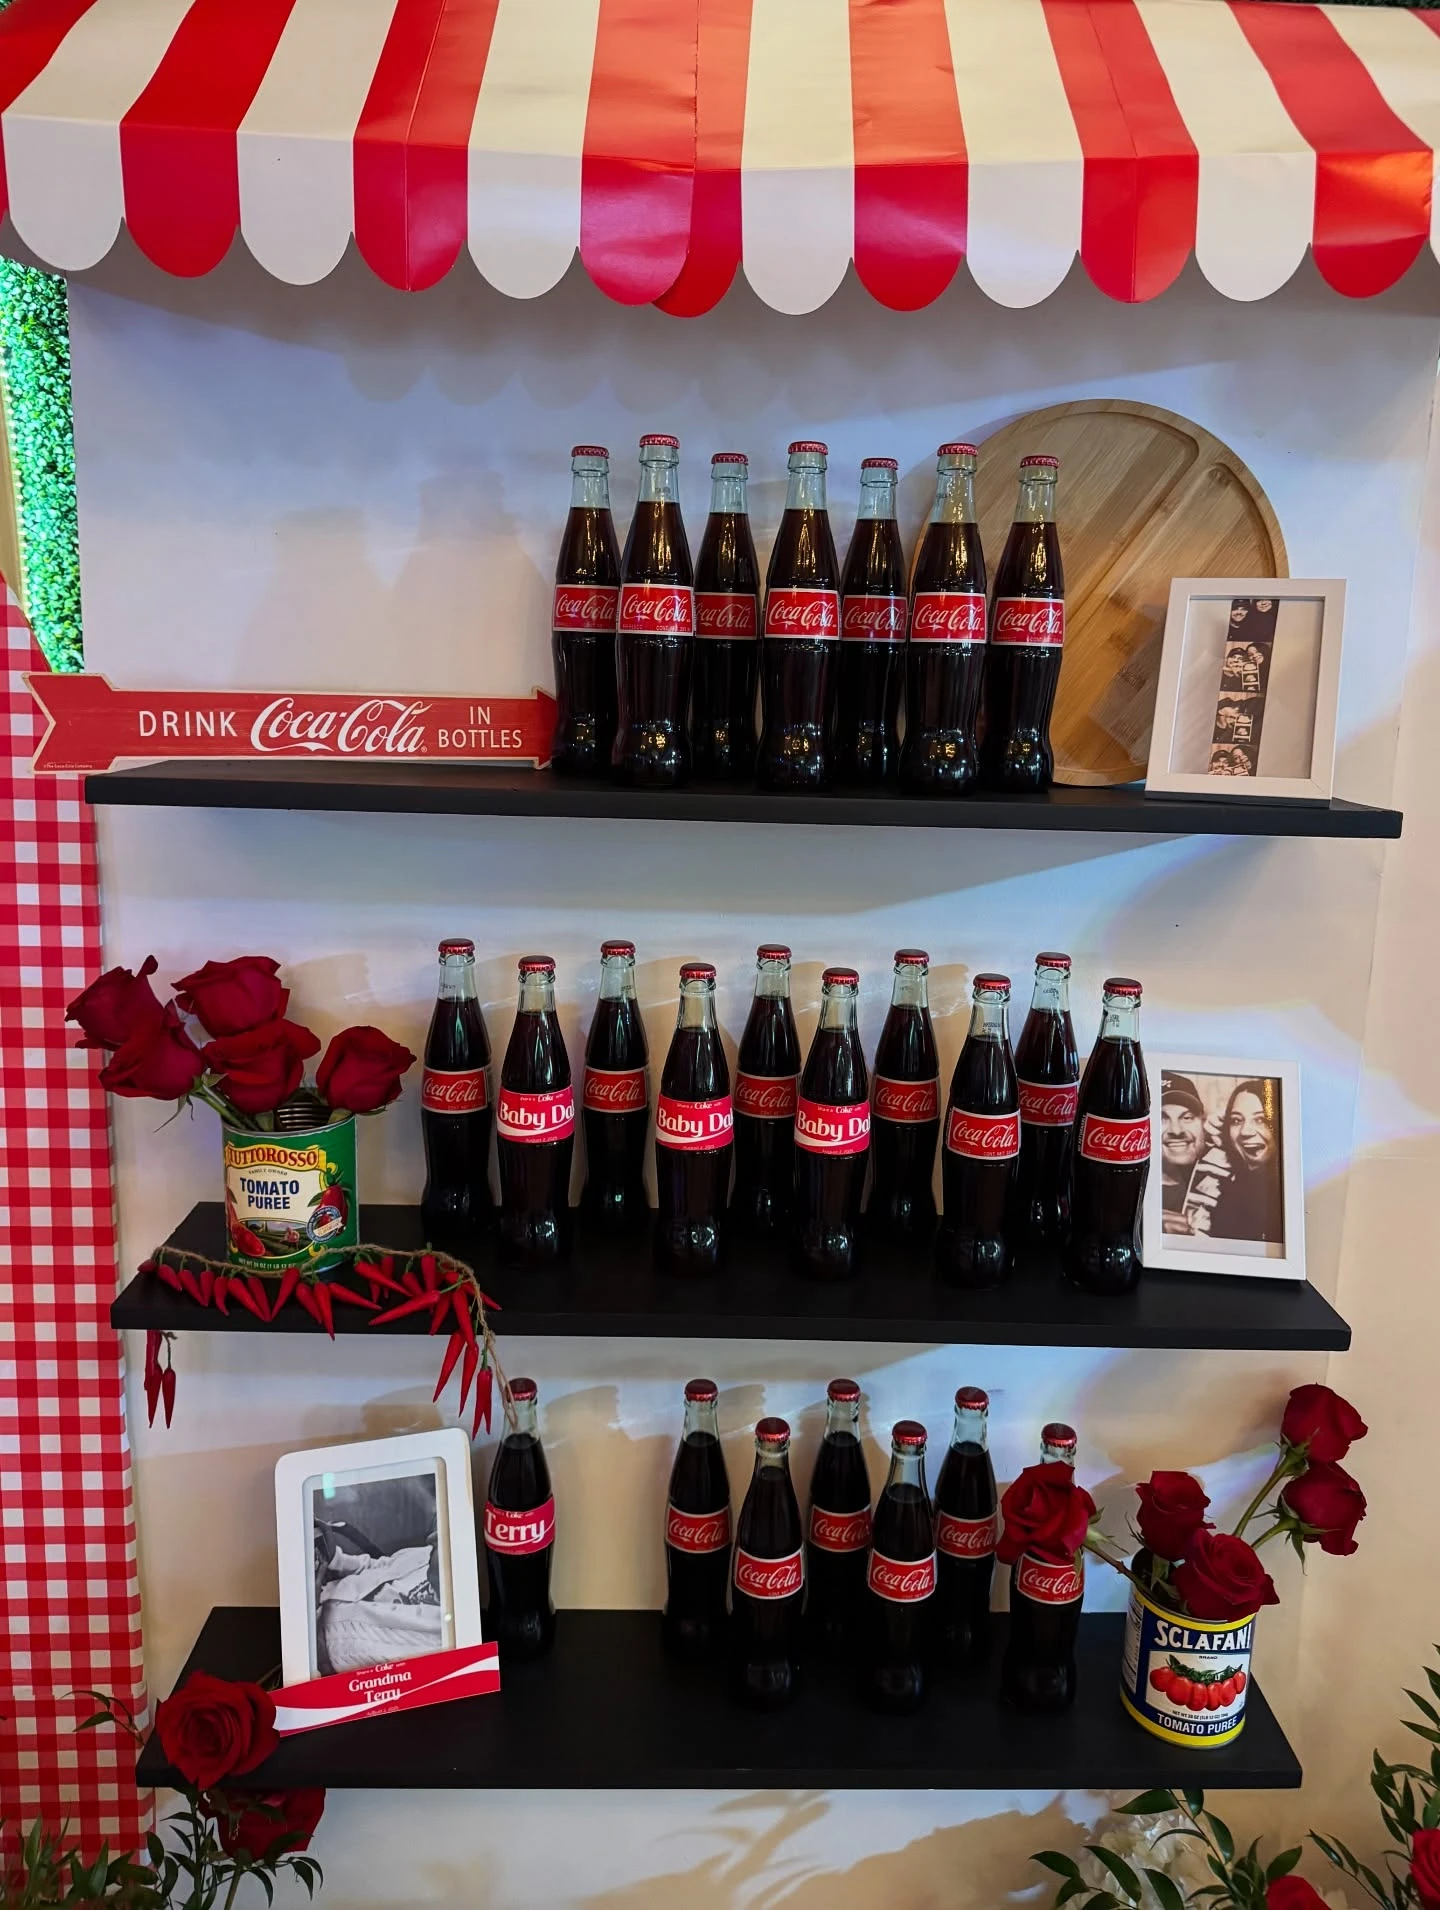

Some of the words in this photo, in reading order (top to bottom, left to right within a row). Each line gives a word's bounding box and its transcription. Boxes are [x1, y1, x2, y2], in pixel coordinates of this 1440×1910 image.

[556, 594, 614, 619] Coca-Cola
[623, 594, 688, 621] Coca-Cola
[769, 599, 834, 628] Coca-Cola
[844, 605, 904, 631] Coca-Cola
[915, 603, 982, 632] Coca-Cola
[997, 607, 1062, 634] Coca-Cola
[139, 711, 238, 737] DRINK
[250, 697, 432, 753] Coca-Cola
[470, 706, 490, 725] IN
[438, 729, 522, 749] BOTTLES
[424, 1078, 480, 1102] Coca-Cola
[537, 1094, 554, 1103] Coke
[585, 1078, 642, 1102] Coca-Cola
[736, 1082, 792, 1108] Coca-Cola
[876, 1087, 935, 1112] Coca-Cola
[500, 1101, 546, 1130] Baby
[694, 1101, 712, 1110] Coke
[835, 1106, 853, 1114] Coke
[658, 1106, 703, 1138] Baby
[797, 1110, 843, 1142] Baby
[953, 1121, 1015, 1148] Coca-Cola
[1087, 1126, 1148, 1152] Coca-Cola
[240, 1177, 299, 1195] TOMATO
[248, 1195, 291, 1210] PUREE
[485, 1508, 545, 1543] Terry
[669, 1518, 724, 1543] Coca-Cola
[814, 1518, 869, 1543] Coca-Cola
[940, 1524, 996, 1549] Coca-Cola
[739, 1562, 797, 1589] Coca-Cola
[873, 1565, 931, 1592] Coca-Cola
[1154, 1620, 1252, 1651] SCLAFANI
[375, 1663, 394, 1672] Coke
[348, 1671, 412, 1692] Grandma
[363, 1688, 401, 1702] Terry
[1157, 1713, 1204, 1734] TOMATO
[1207, 1716, 1237, 1734] PUREE
